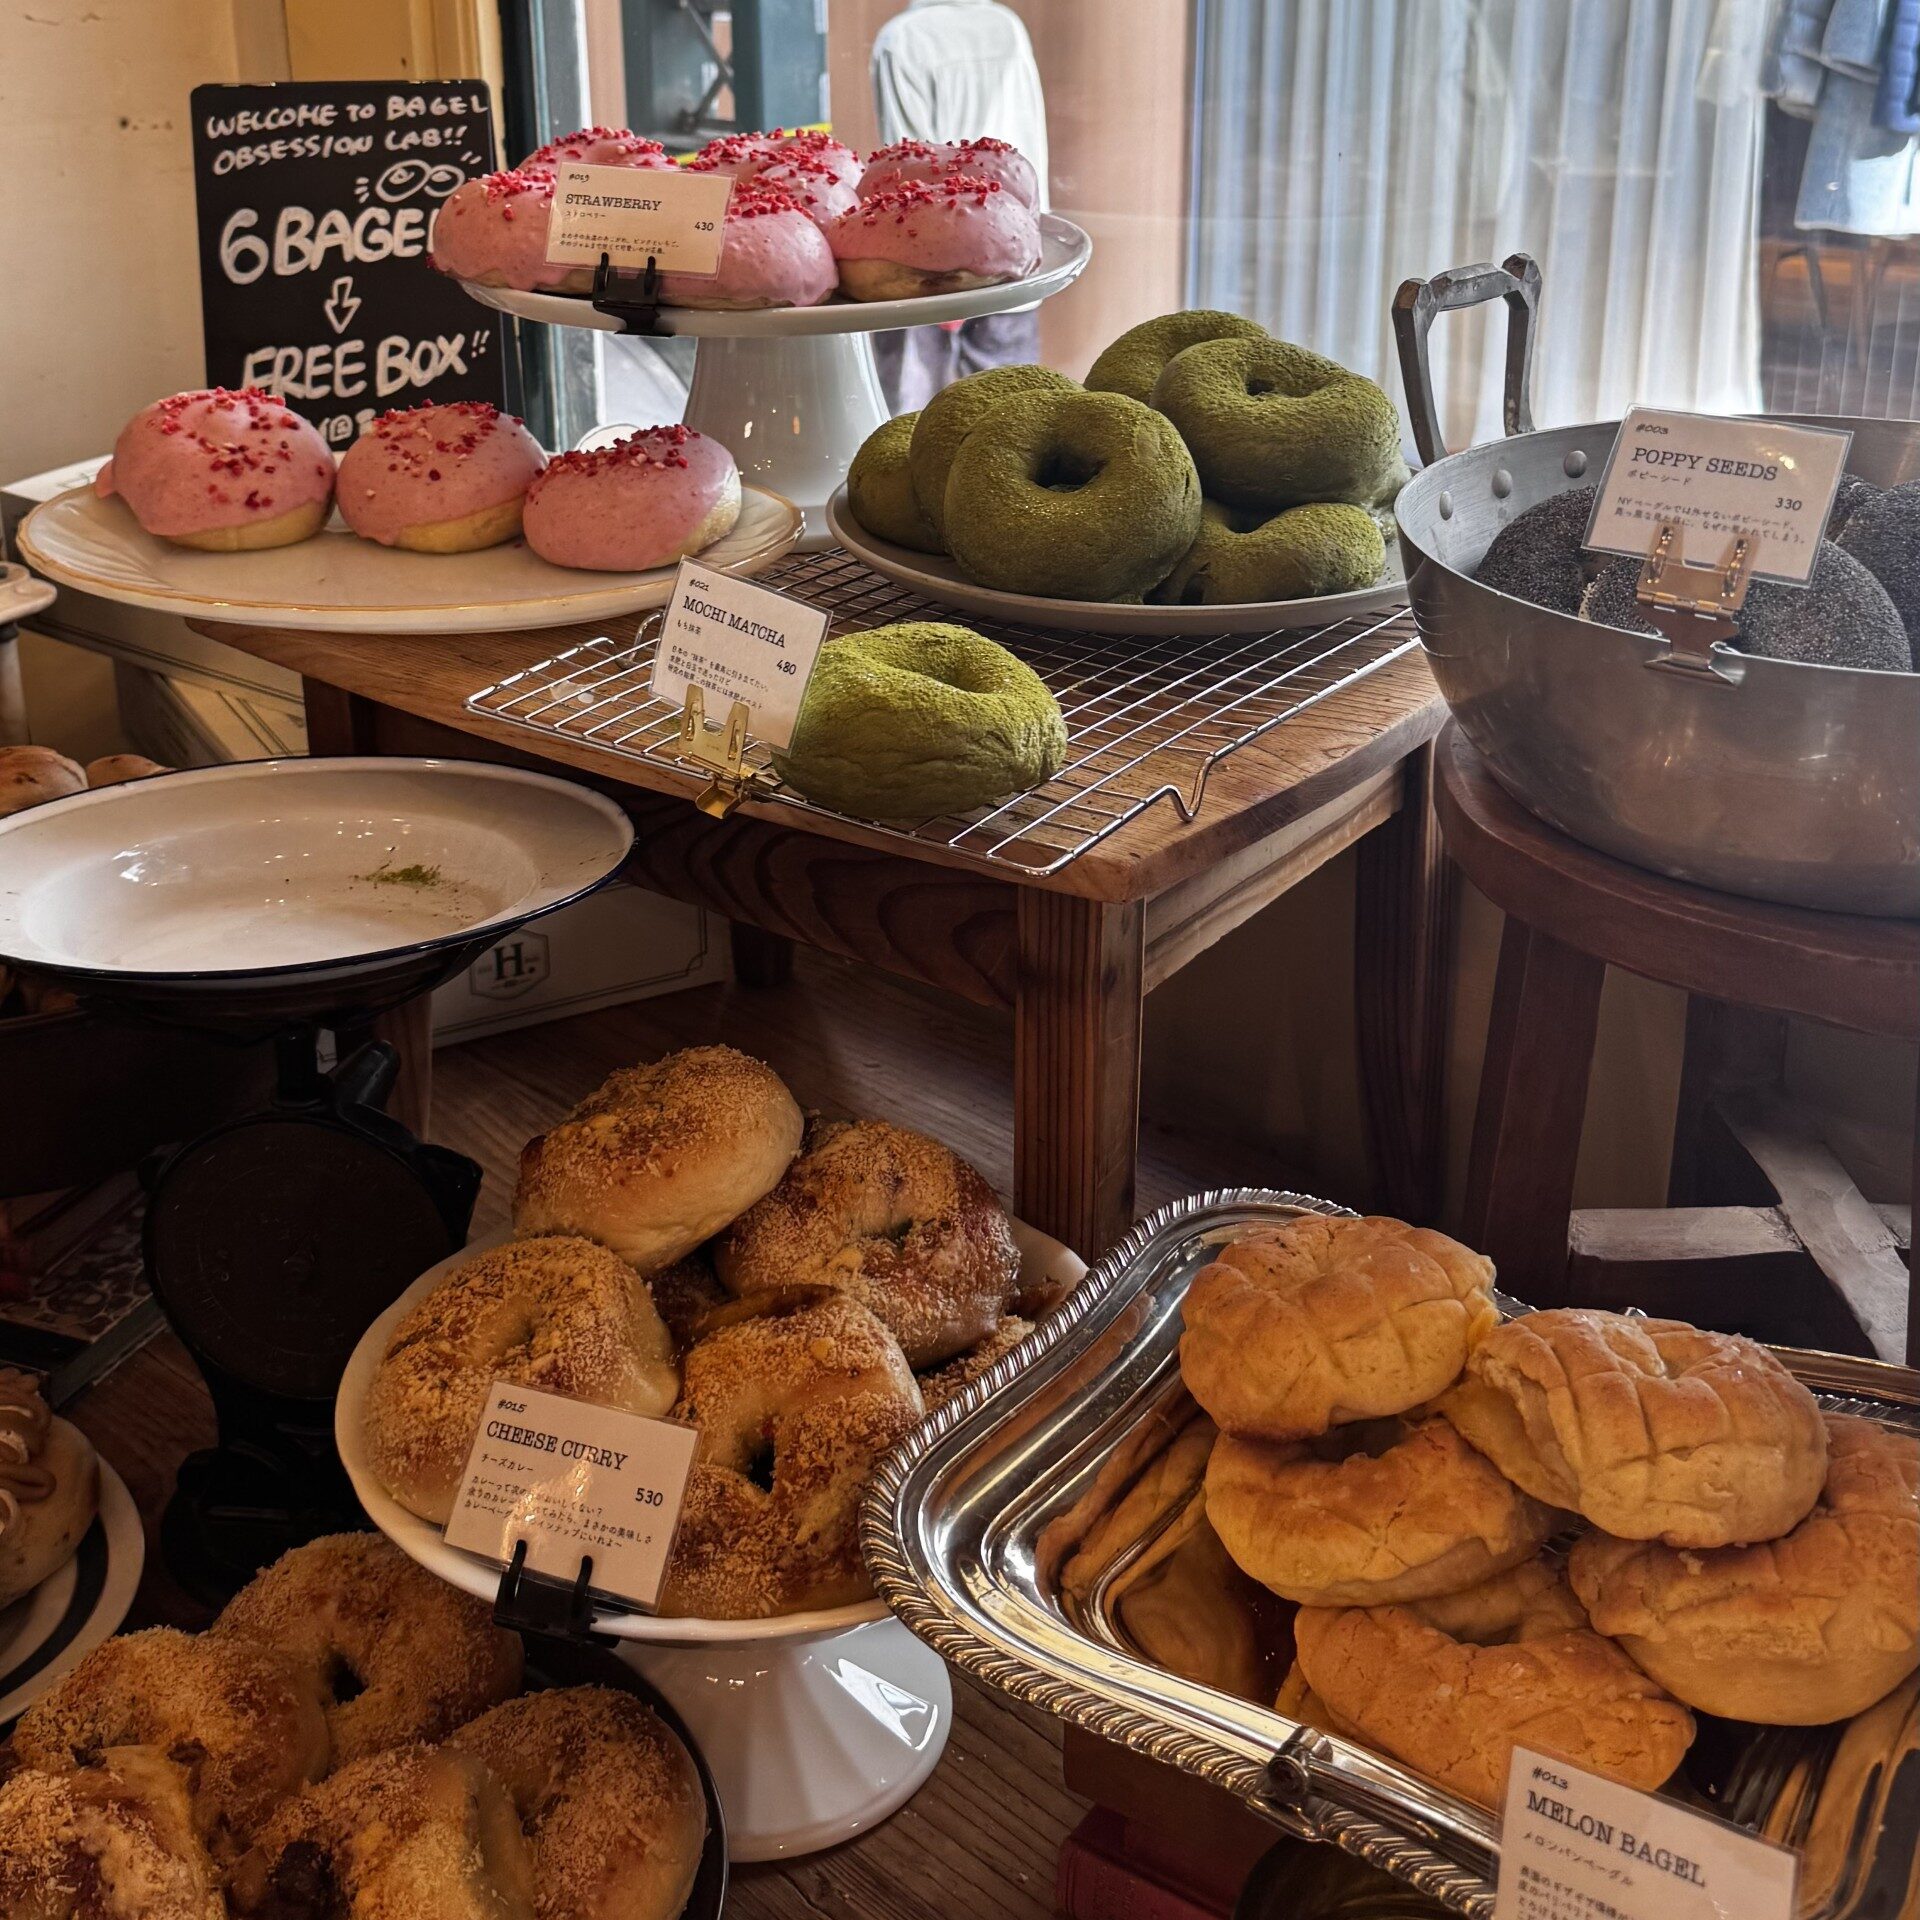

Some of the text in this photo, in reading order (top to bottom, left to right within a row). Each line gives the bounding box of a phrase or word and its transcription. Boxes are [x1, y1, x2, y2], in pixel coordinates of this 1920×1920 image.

[207, 95, 488, 139] WELCOME TO BAGEL
[212, 135, 373, 175] OBSESSION
[565, 194, 662, 211] STRAWBERRY
[694, 222, 714, 232] 430
[219, 207, 269, 285] 6
[242, 339, 367, 399] FREE
[1635, 424, 1669, 435] #003
[1631, 447, 1778, 481] POPPY SEEDS
[1775, 498, 1802, 512] 330
[689, 579, 709, 592] #021
[677, 619, 702, 635] もち抹茶
[683, 596, 786, 648] MOCHI MATCHA
[776, 659, 797, 676] 480
[497, 1399, 527, 1413] #015
[486, 1420, 629, 1471] CHEESE CURRY
[481, 1453, 534, 1472] チーズカレー
[635, 1487, 664, 1507] 530
[1532, 1766, 1569, 1790] #013
[1527, 1789, 1706, 1888] MELON BAGEL
